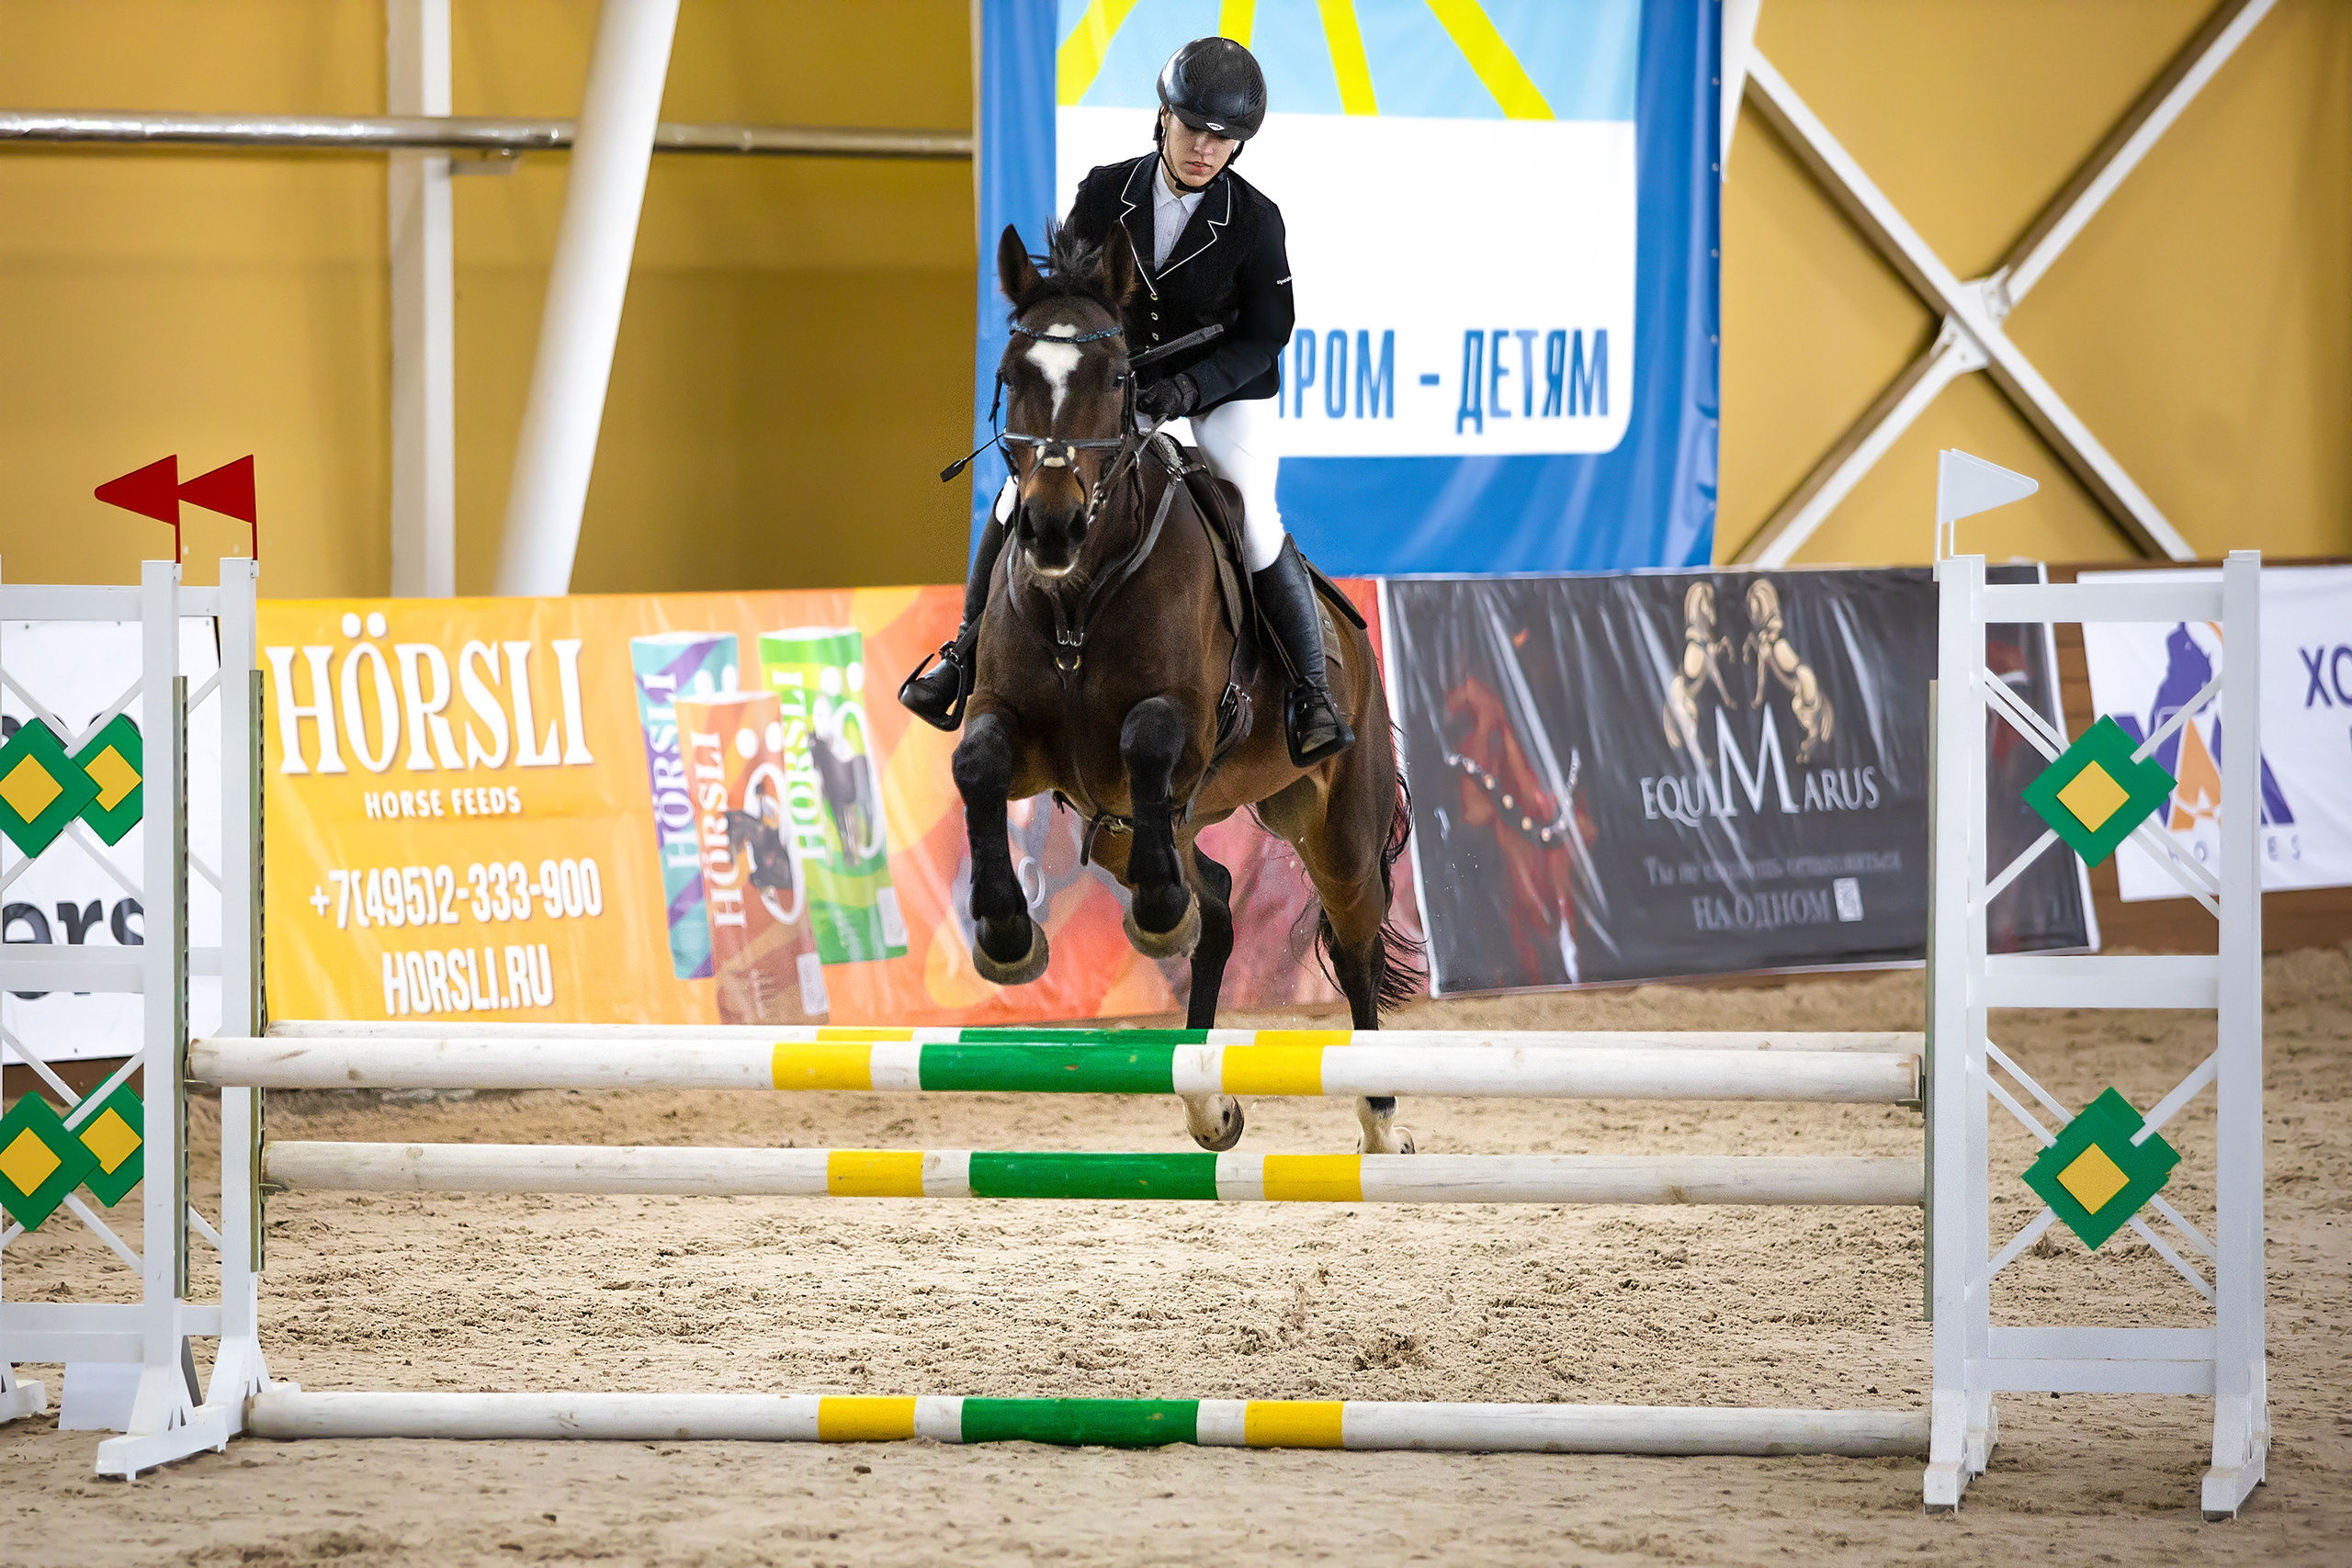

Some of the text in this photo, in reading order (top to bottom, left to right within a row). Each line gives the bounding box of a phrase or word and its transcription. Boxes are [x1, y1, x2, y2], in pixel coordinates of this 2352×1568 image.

[1278, 328, 1395, 419] РОМ
[1455, 328, 1609, 434] ДЕТЯМ
[264, 612, 595, 774] HÖRSLI
[364, 785, 522, 820] HORSE FEEDS
[309, 857, 603, 929] +7(495)2-333-900
[381, 943, 554, 1015] HORSLI.RU
